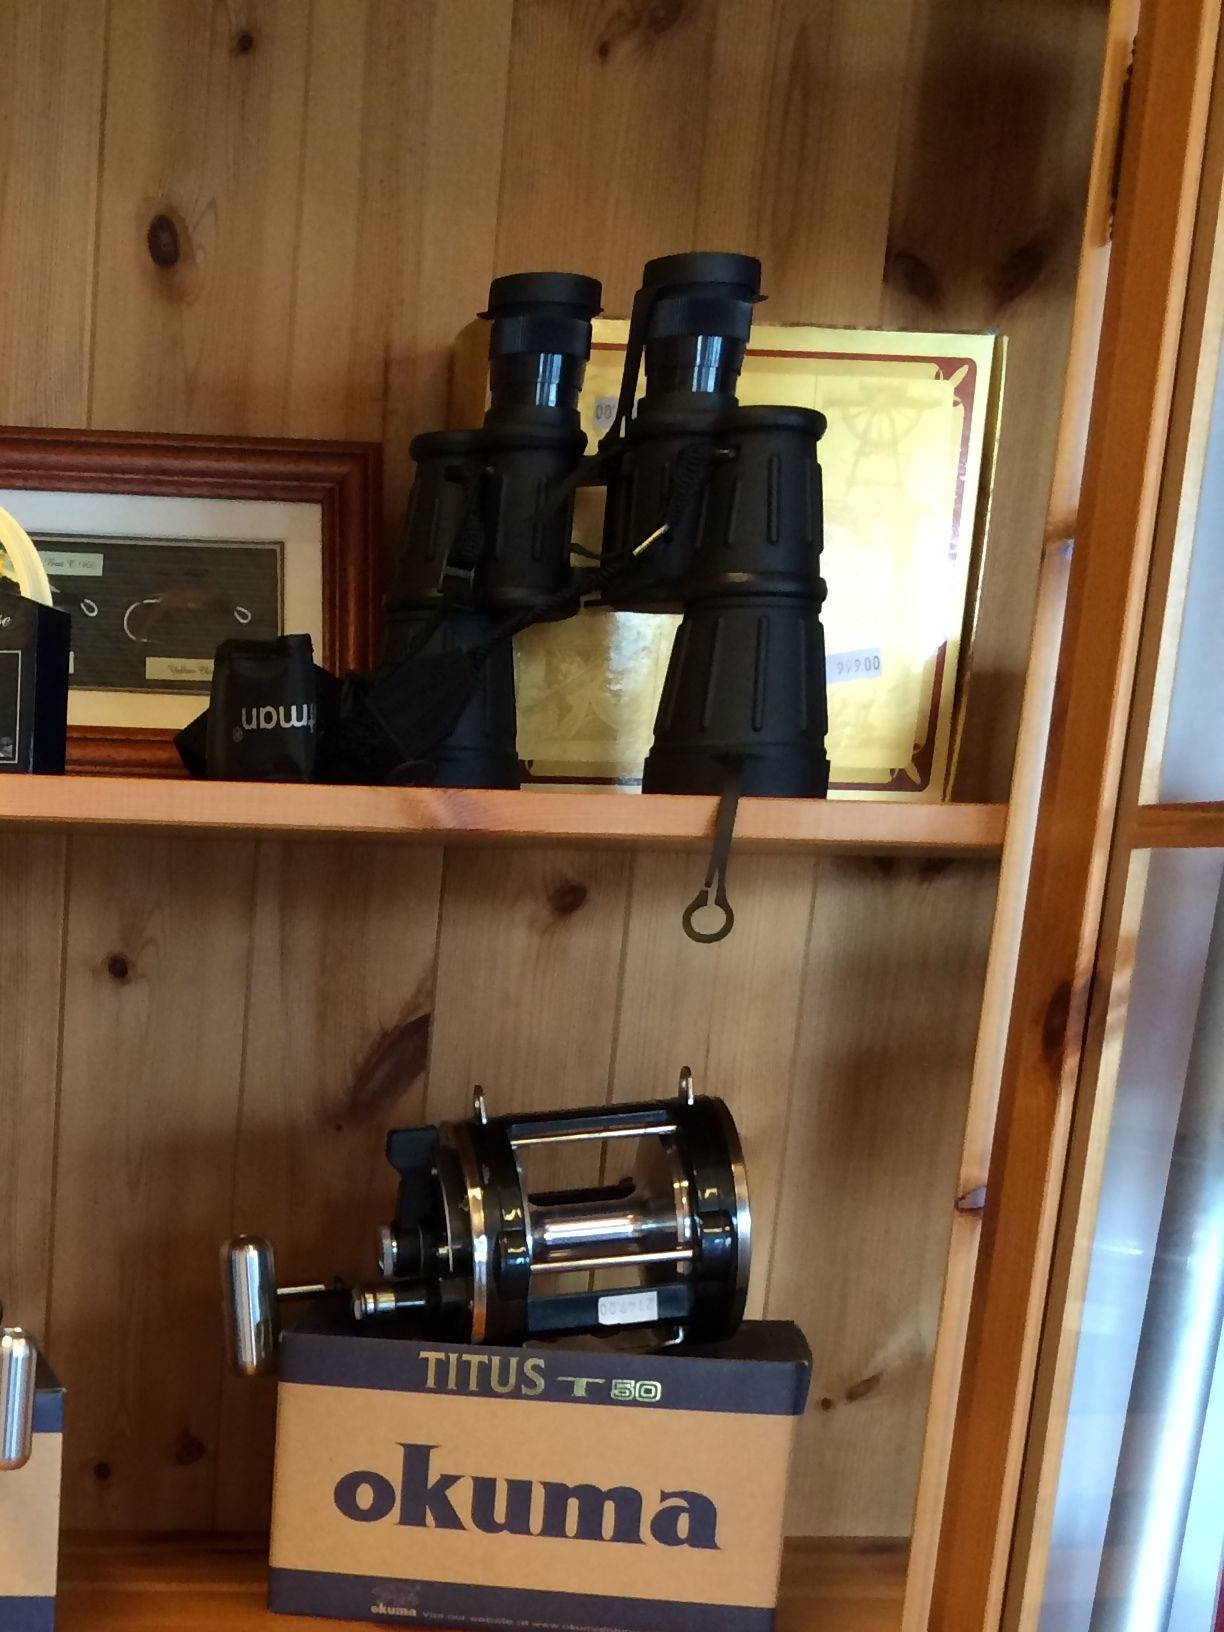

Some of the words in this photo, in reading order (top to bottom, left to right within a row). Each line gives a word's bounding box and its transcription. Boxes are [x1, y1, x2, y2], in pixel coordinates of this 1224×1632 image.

[419, 1351, 545, 1396] TITUS
[557, 1377, 606, 1397] T
[610, 1379, 663, 1402] 50
[333, 1442, 722, 1550] okuma
[369, 1603, 417, 1617] okuma
